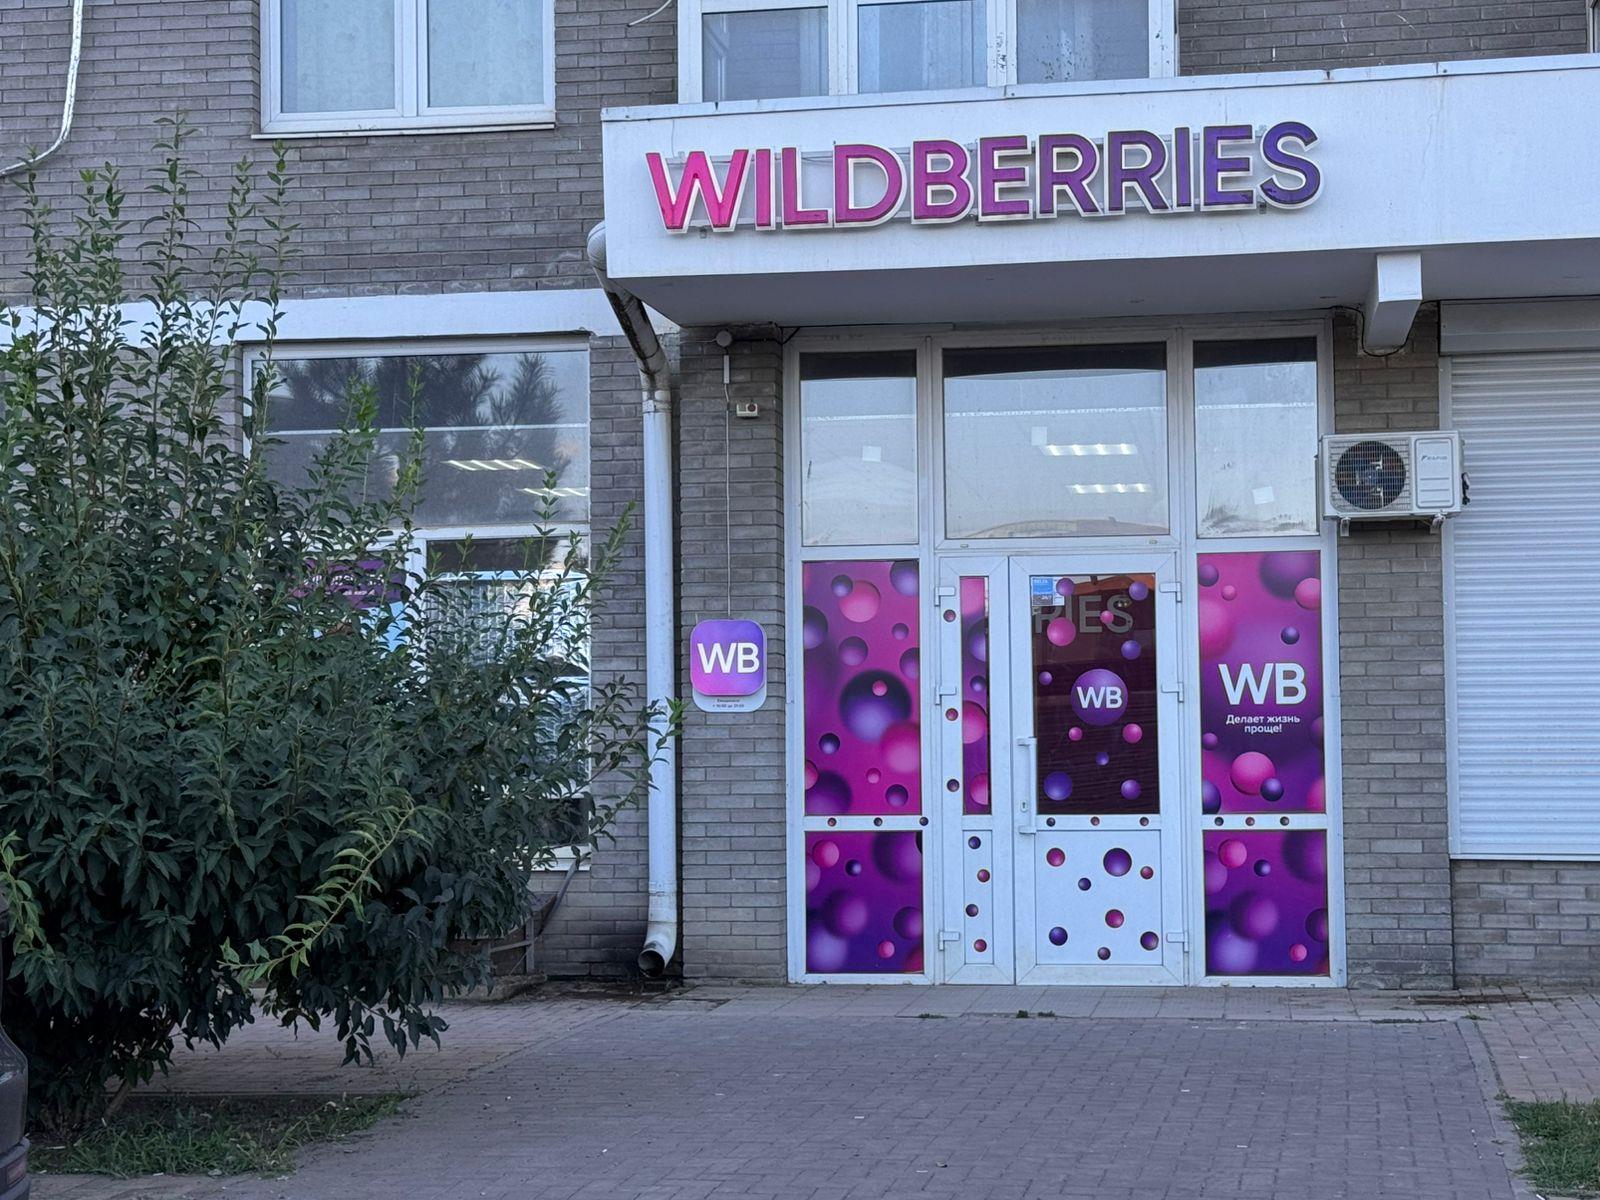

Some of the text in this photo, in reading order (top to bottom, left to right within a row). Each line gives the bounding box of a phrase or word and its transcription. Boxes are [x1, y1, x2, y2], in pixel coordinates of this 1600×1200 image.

[645, 120, 1322, 234] WILDBERRIES
[697, 642, 760, 674] WB
[1076, 686, 1123, 709] WB
[1218, 663, 1307, 705] WB
[1226, 714, 1301, 725] Делает жизнь
[1244, 723, 1282, 735] проще!
